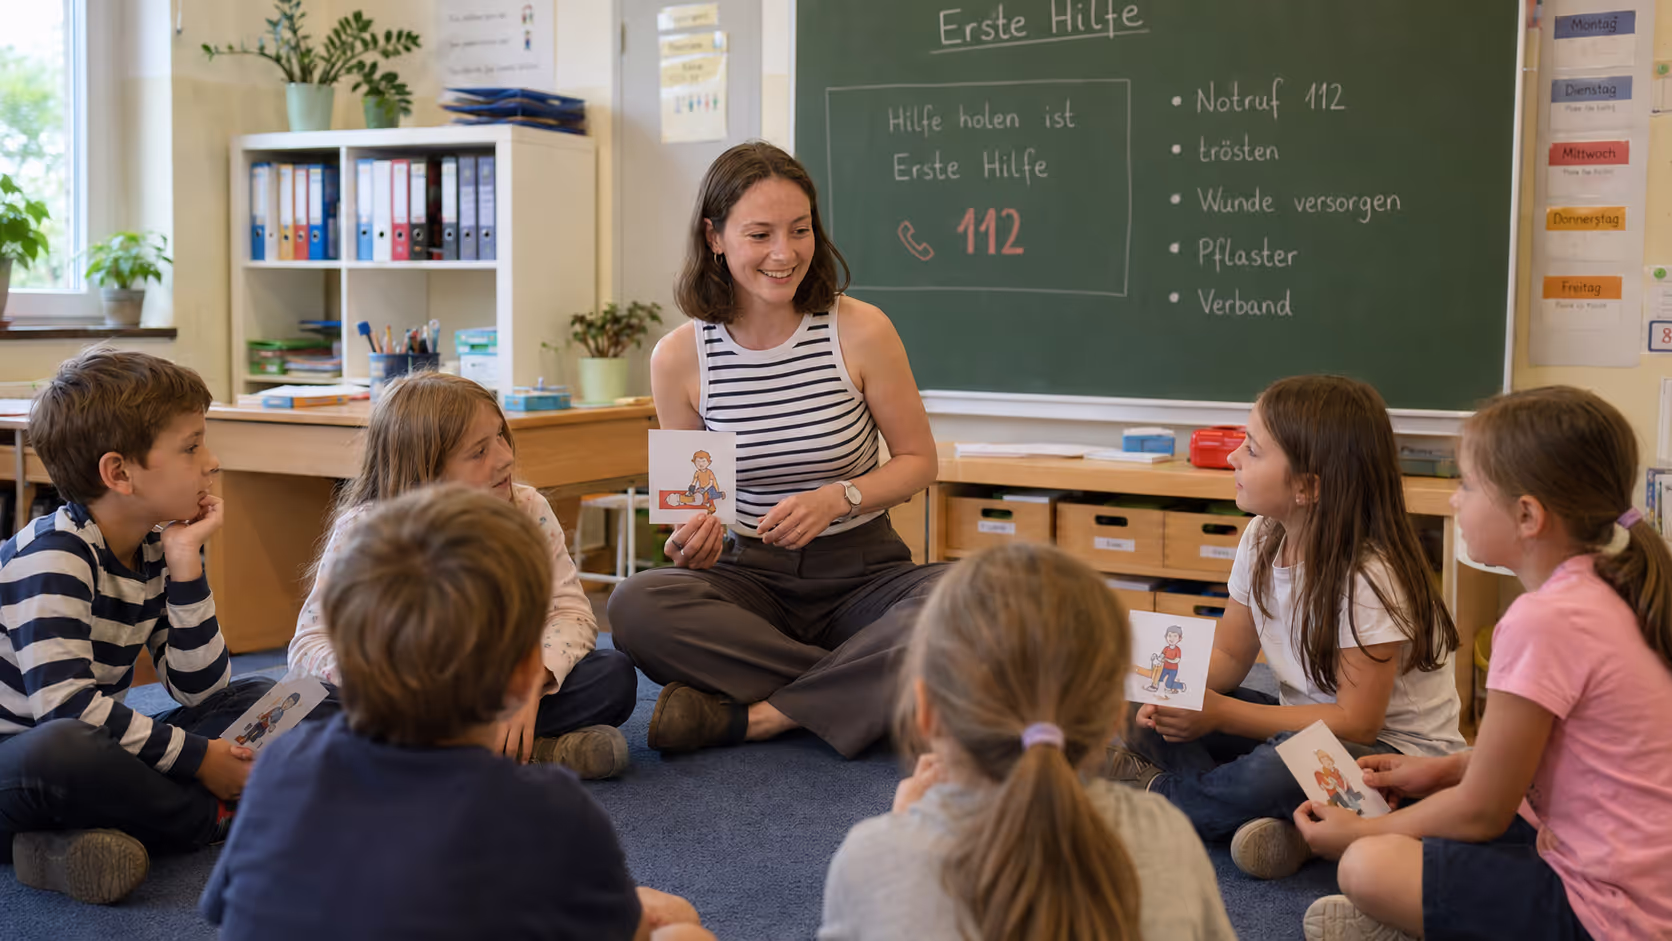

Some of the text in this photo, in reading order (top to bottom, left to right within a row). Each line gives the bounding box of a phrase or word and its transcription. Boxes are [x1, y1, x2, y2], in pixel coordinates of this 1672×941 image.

[939, 0, 1143, 45] Erste Hilfe
[1570, 16, 1618, 33] Montag
[1197, 78, 1345, 119] Notruf 112
[1565, 83, 1617, 98] Dienstag
[889, 98, 1075, 137] Hilfe holen ist
[1199, 134, 1279, 162] trösten
[1562, 145, 1617, 161] Mittwoch
[893, 148, 1049, 186] Erste Hilfe
[1197, 187, 1401, 223] Wunde versorgen
[1554, 212, 1619, 229] Donnerstag
[956, 207, 1025, 256] 112
[1199, 235, 1298, 272] Pflaster
[1198, 289, 1293, 316] Verband
[1561, 280, 1602, 297] Freitag
